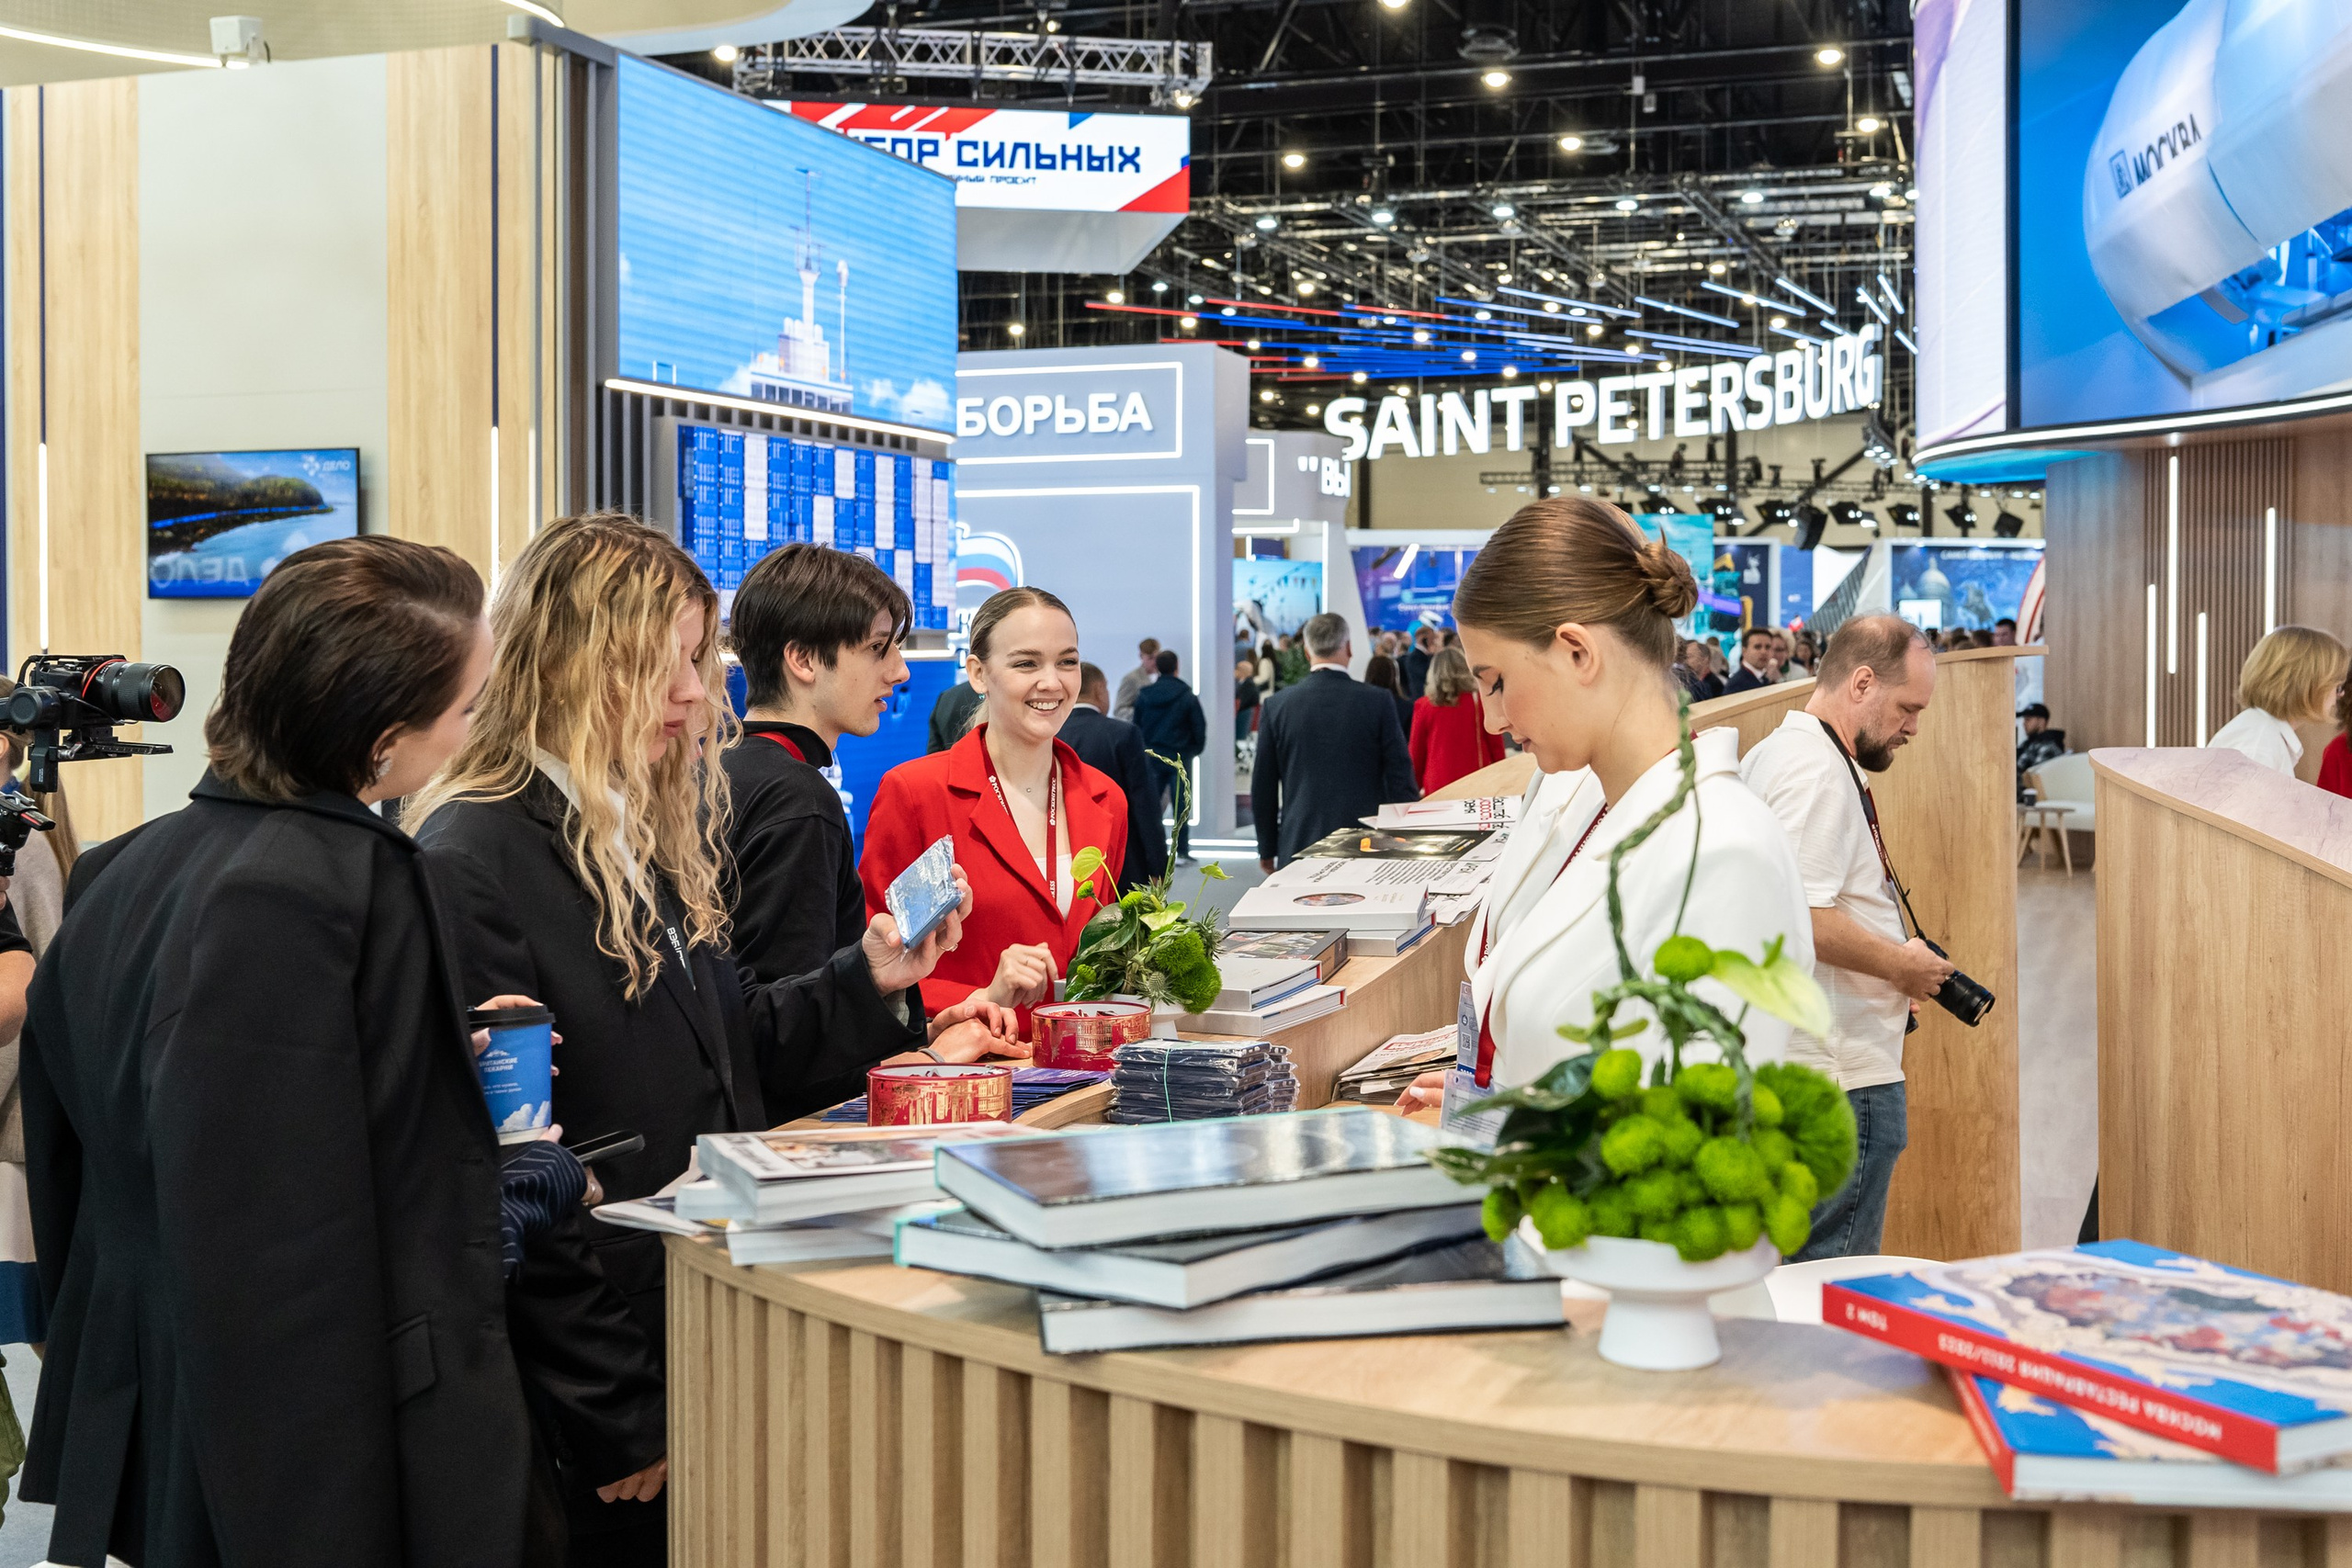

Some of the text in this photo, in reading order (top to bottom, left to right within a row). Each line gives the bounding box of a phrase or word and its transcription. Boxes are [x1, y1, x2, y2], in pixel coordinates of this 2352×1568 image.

[956, 141, 1141, 173] СИЛЬНЫХ
[956, 392, 1153, 437] БОРЬБА
[1324, 324, 1883, 460] SAINT PETERSBURG
